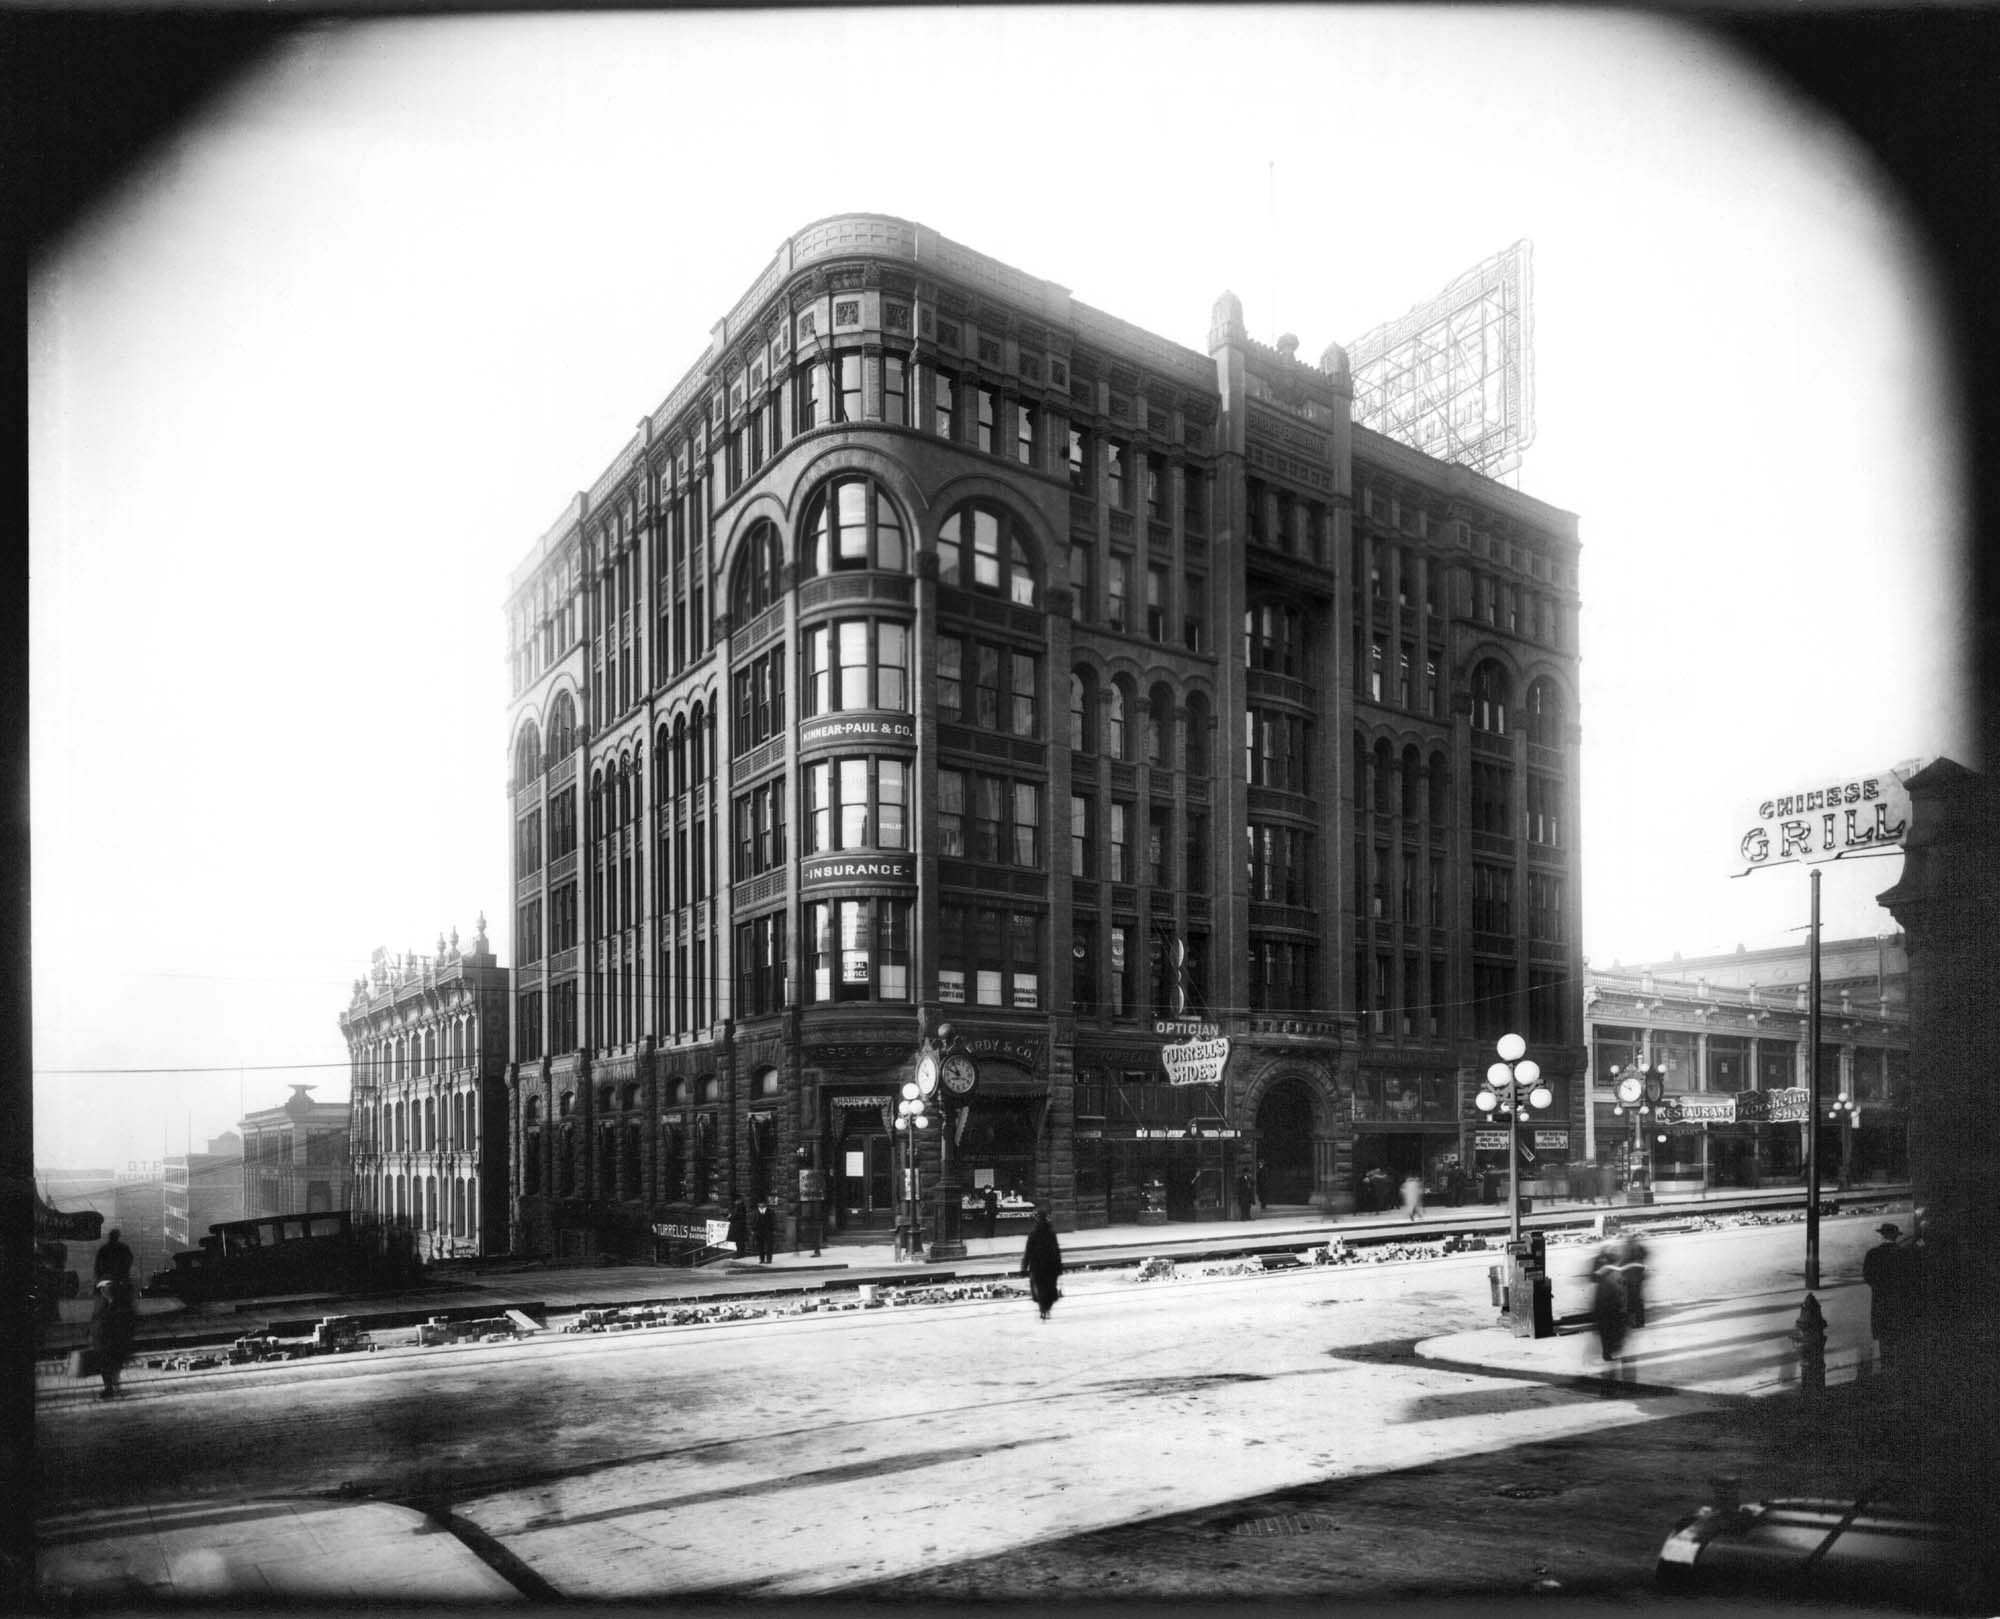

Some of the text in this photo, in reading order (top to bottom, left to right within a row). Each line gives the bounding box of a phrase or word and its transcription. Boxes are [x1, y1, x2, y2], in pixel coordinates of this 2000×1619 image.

[803, 722, 913, 743] KINNEAR-PAUL & CO.
[1759, 779, 1879, 820] CHINESE
[1740, 803, 1906, 862] GRILL
[1156, 1022, 1219, 1036] OPTICIAN
[1163, 1039, 1226, 1064] TURRELL'S
[1171, 1063, 1217, 1083] SHOES
[1656, 1106, 1732, 1119] RESTAURANT
